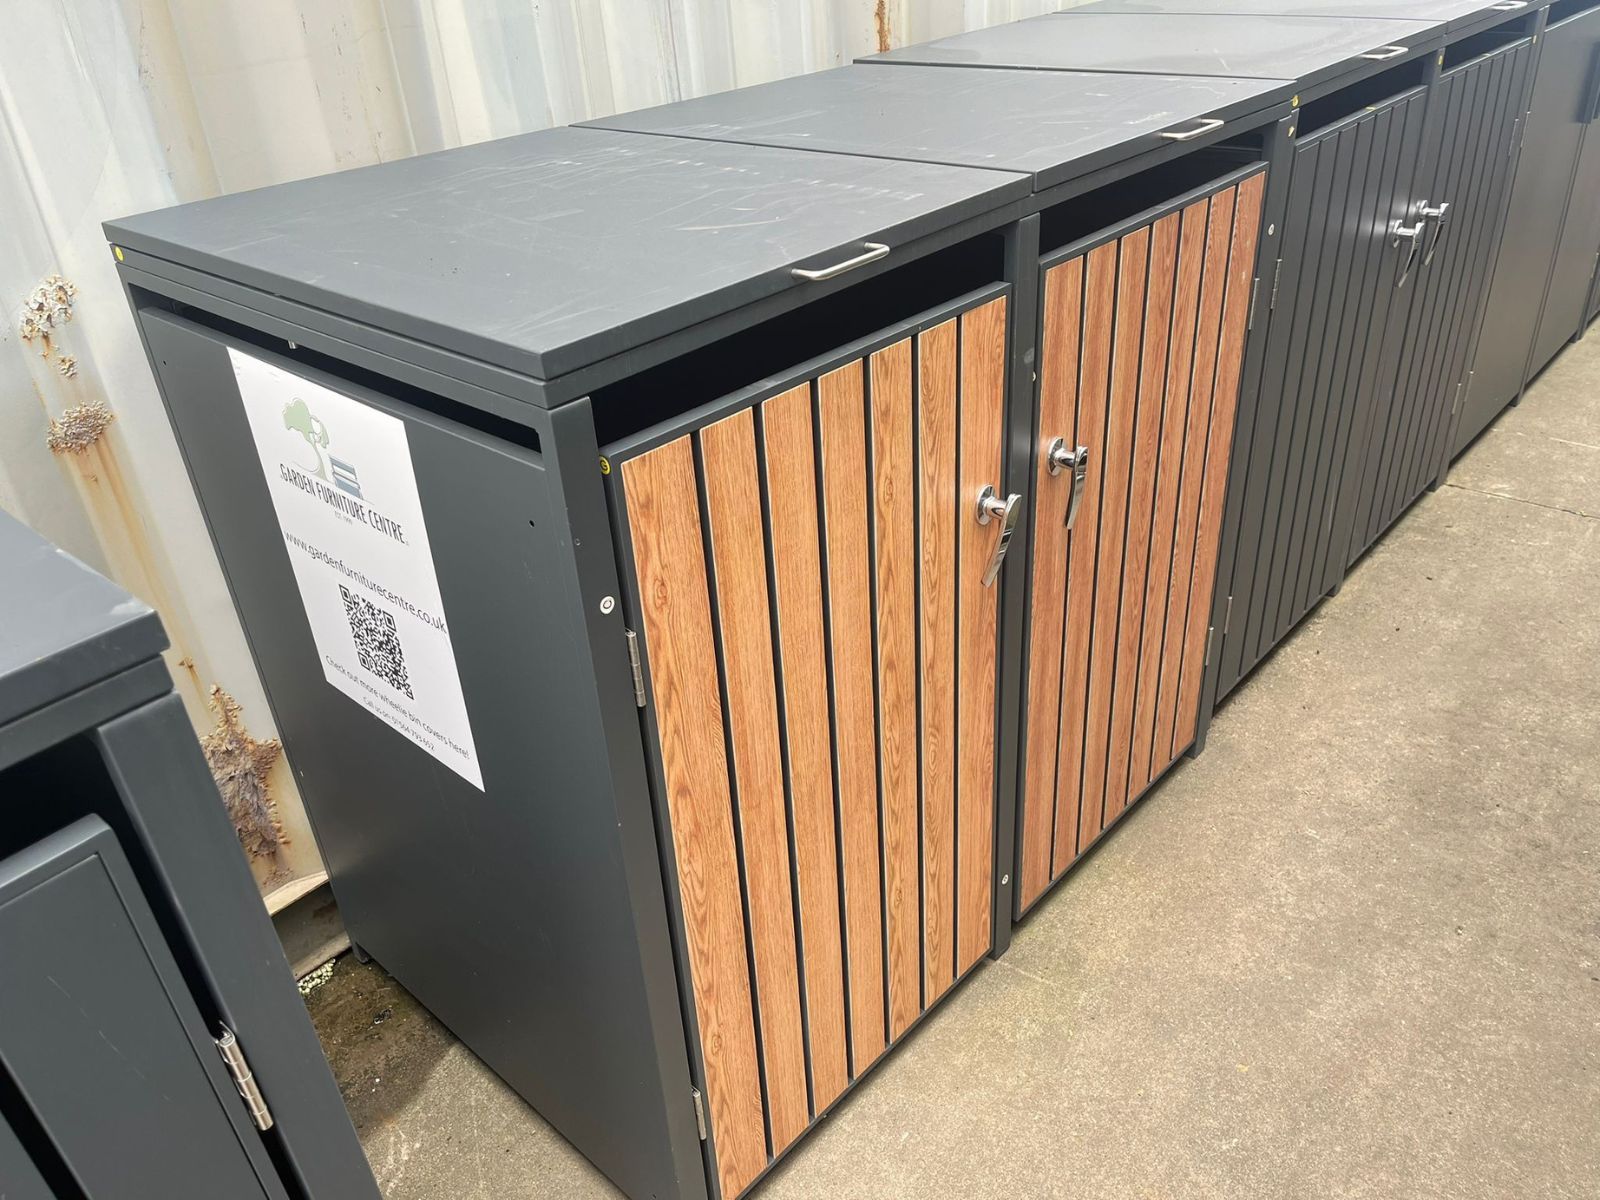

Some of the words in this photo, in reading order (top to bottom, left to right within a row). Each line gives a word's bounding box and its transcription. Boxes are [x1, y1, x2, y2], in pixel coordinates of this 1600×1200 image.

[280, 463, 316, 497] GARDEN
[315, 481, 367, 525] FURNITURE
[368, 509, 405, 545] CENTRE
[284, 531, 448, 633] www.gardenfurniturecentre.co.uk
[325, 655, 347, 677] Check
[346, 671, 360, 685] out
[359, 680, 379, 698] more
[379, 691, 408, 718] wheelie
[407, 709, 422, 727] bin
[422, 722, 448, 745] covers
[447, 738, 470, 760] here!
